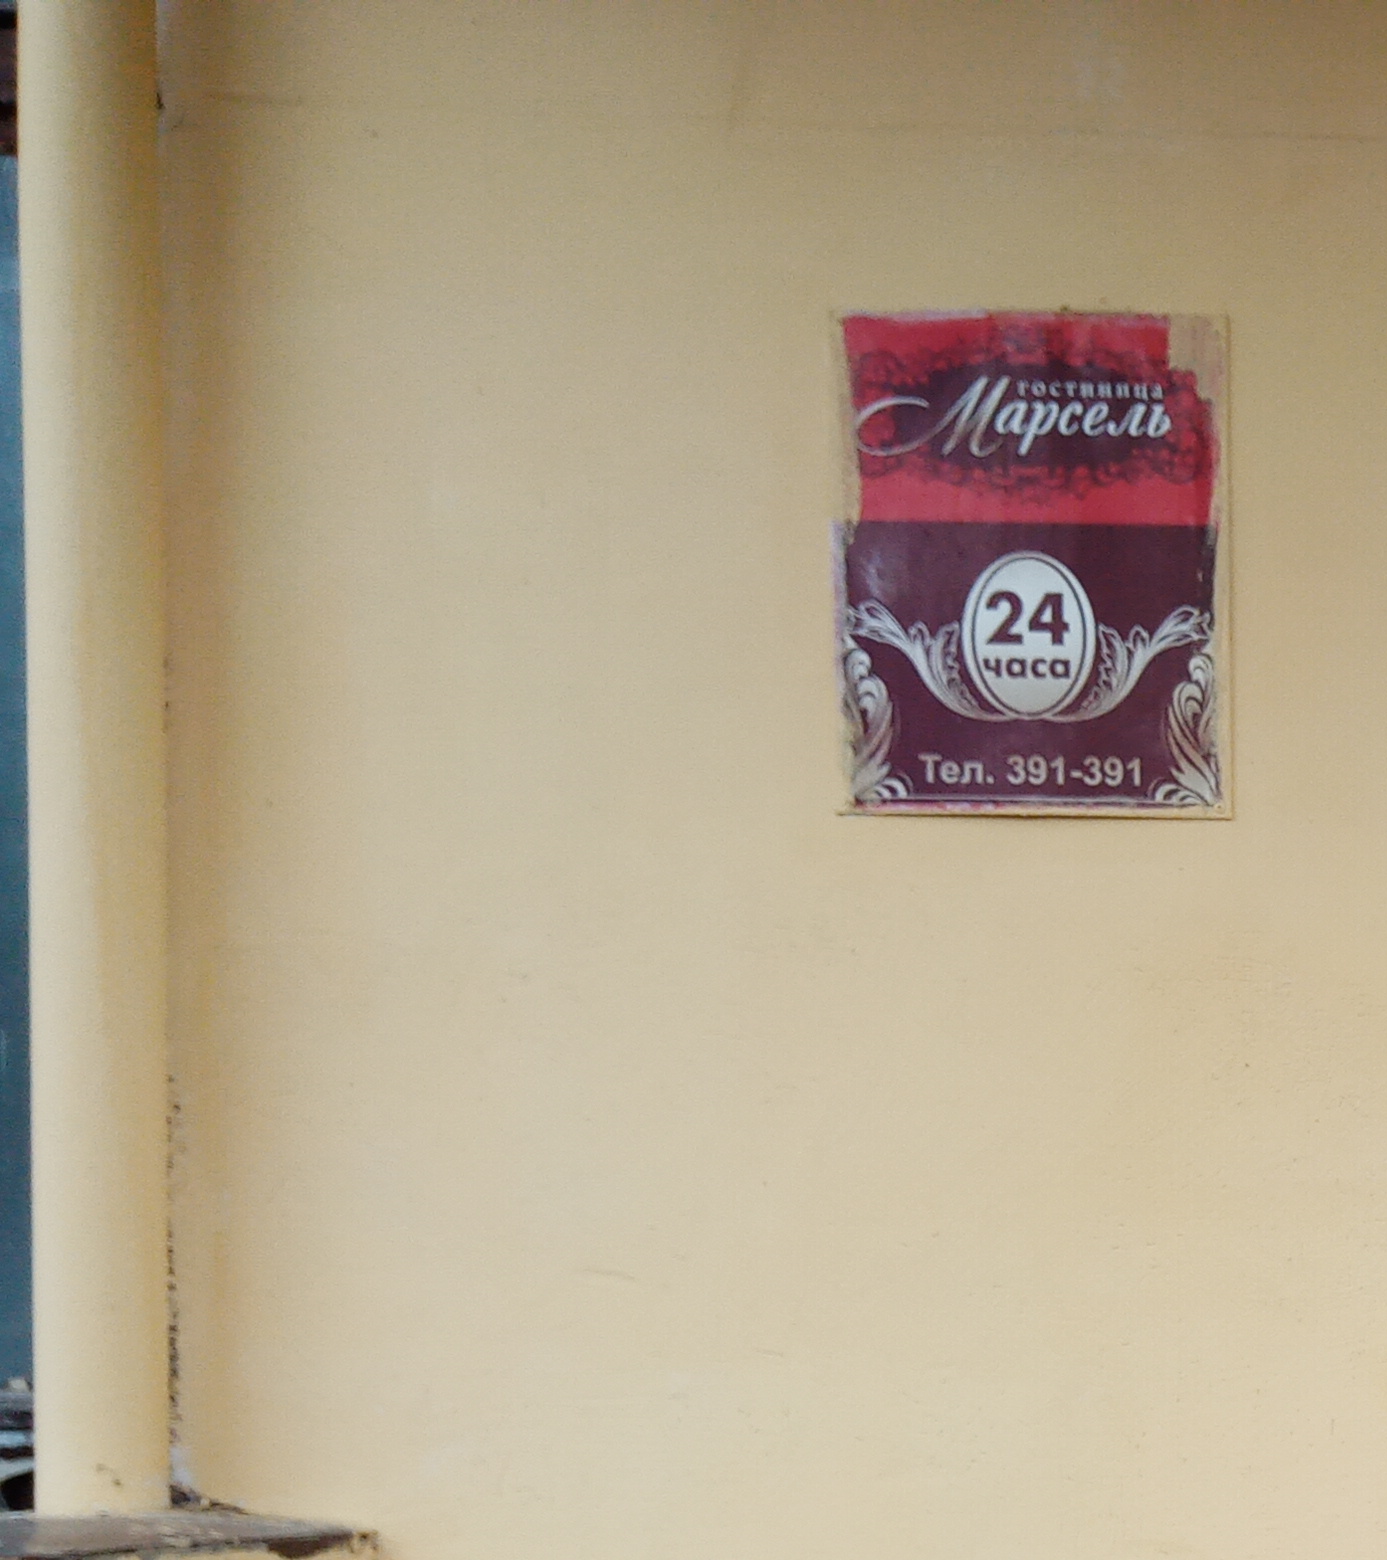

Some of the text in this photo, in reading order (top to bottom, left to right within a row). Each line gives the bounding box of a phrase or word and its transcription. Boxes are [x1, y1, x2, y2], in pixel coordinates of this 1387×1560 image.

[1016, 378, 1164, 401] гостиница
[855, 374, 1172, 458] Марсель
[985, 590, 1070, 646] 24
[983, 657, 1071, 679] часа
[918, 753, 1142, 787] Тел. 391-391
